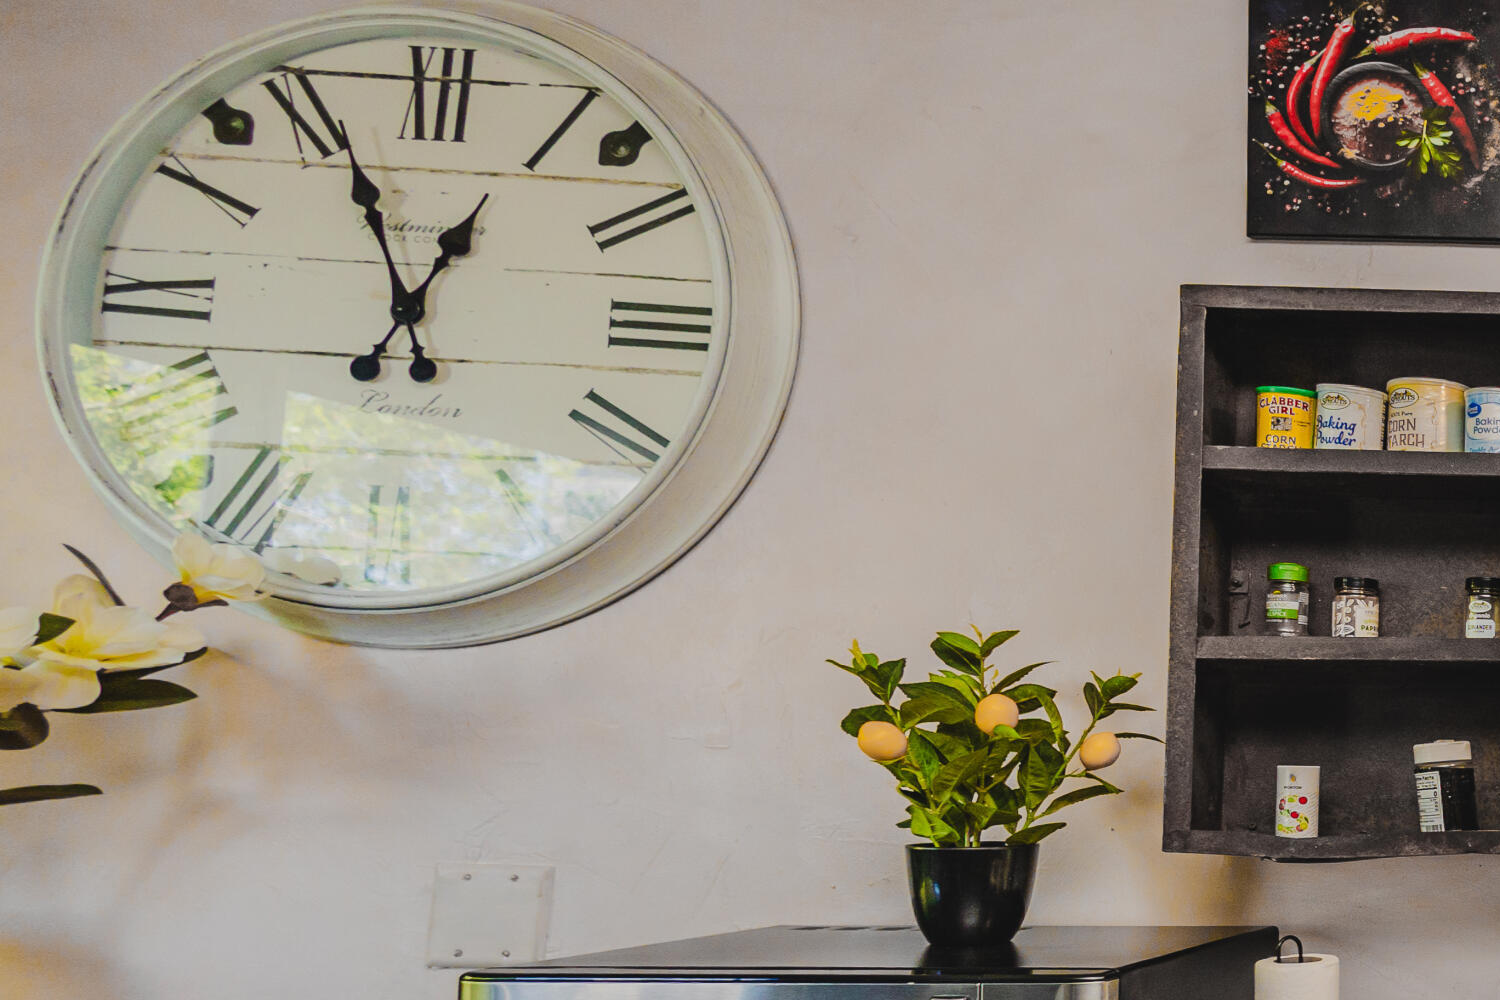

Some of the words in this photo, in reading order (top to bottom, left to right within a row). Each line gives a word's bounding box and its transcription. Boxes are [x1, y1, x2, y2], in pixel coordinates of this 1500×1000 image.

[399, 46, 475, 142] XII
[359, 389, 463, 418] London
[1260, 397, 1309, 412] CLABBER
[1269, 405, 1296, 416] GIRL
[1315, 415, 1356, 436] Baking
[1265, 433, 1297, 445] CORN
